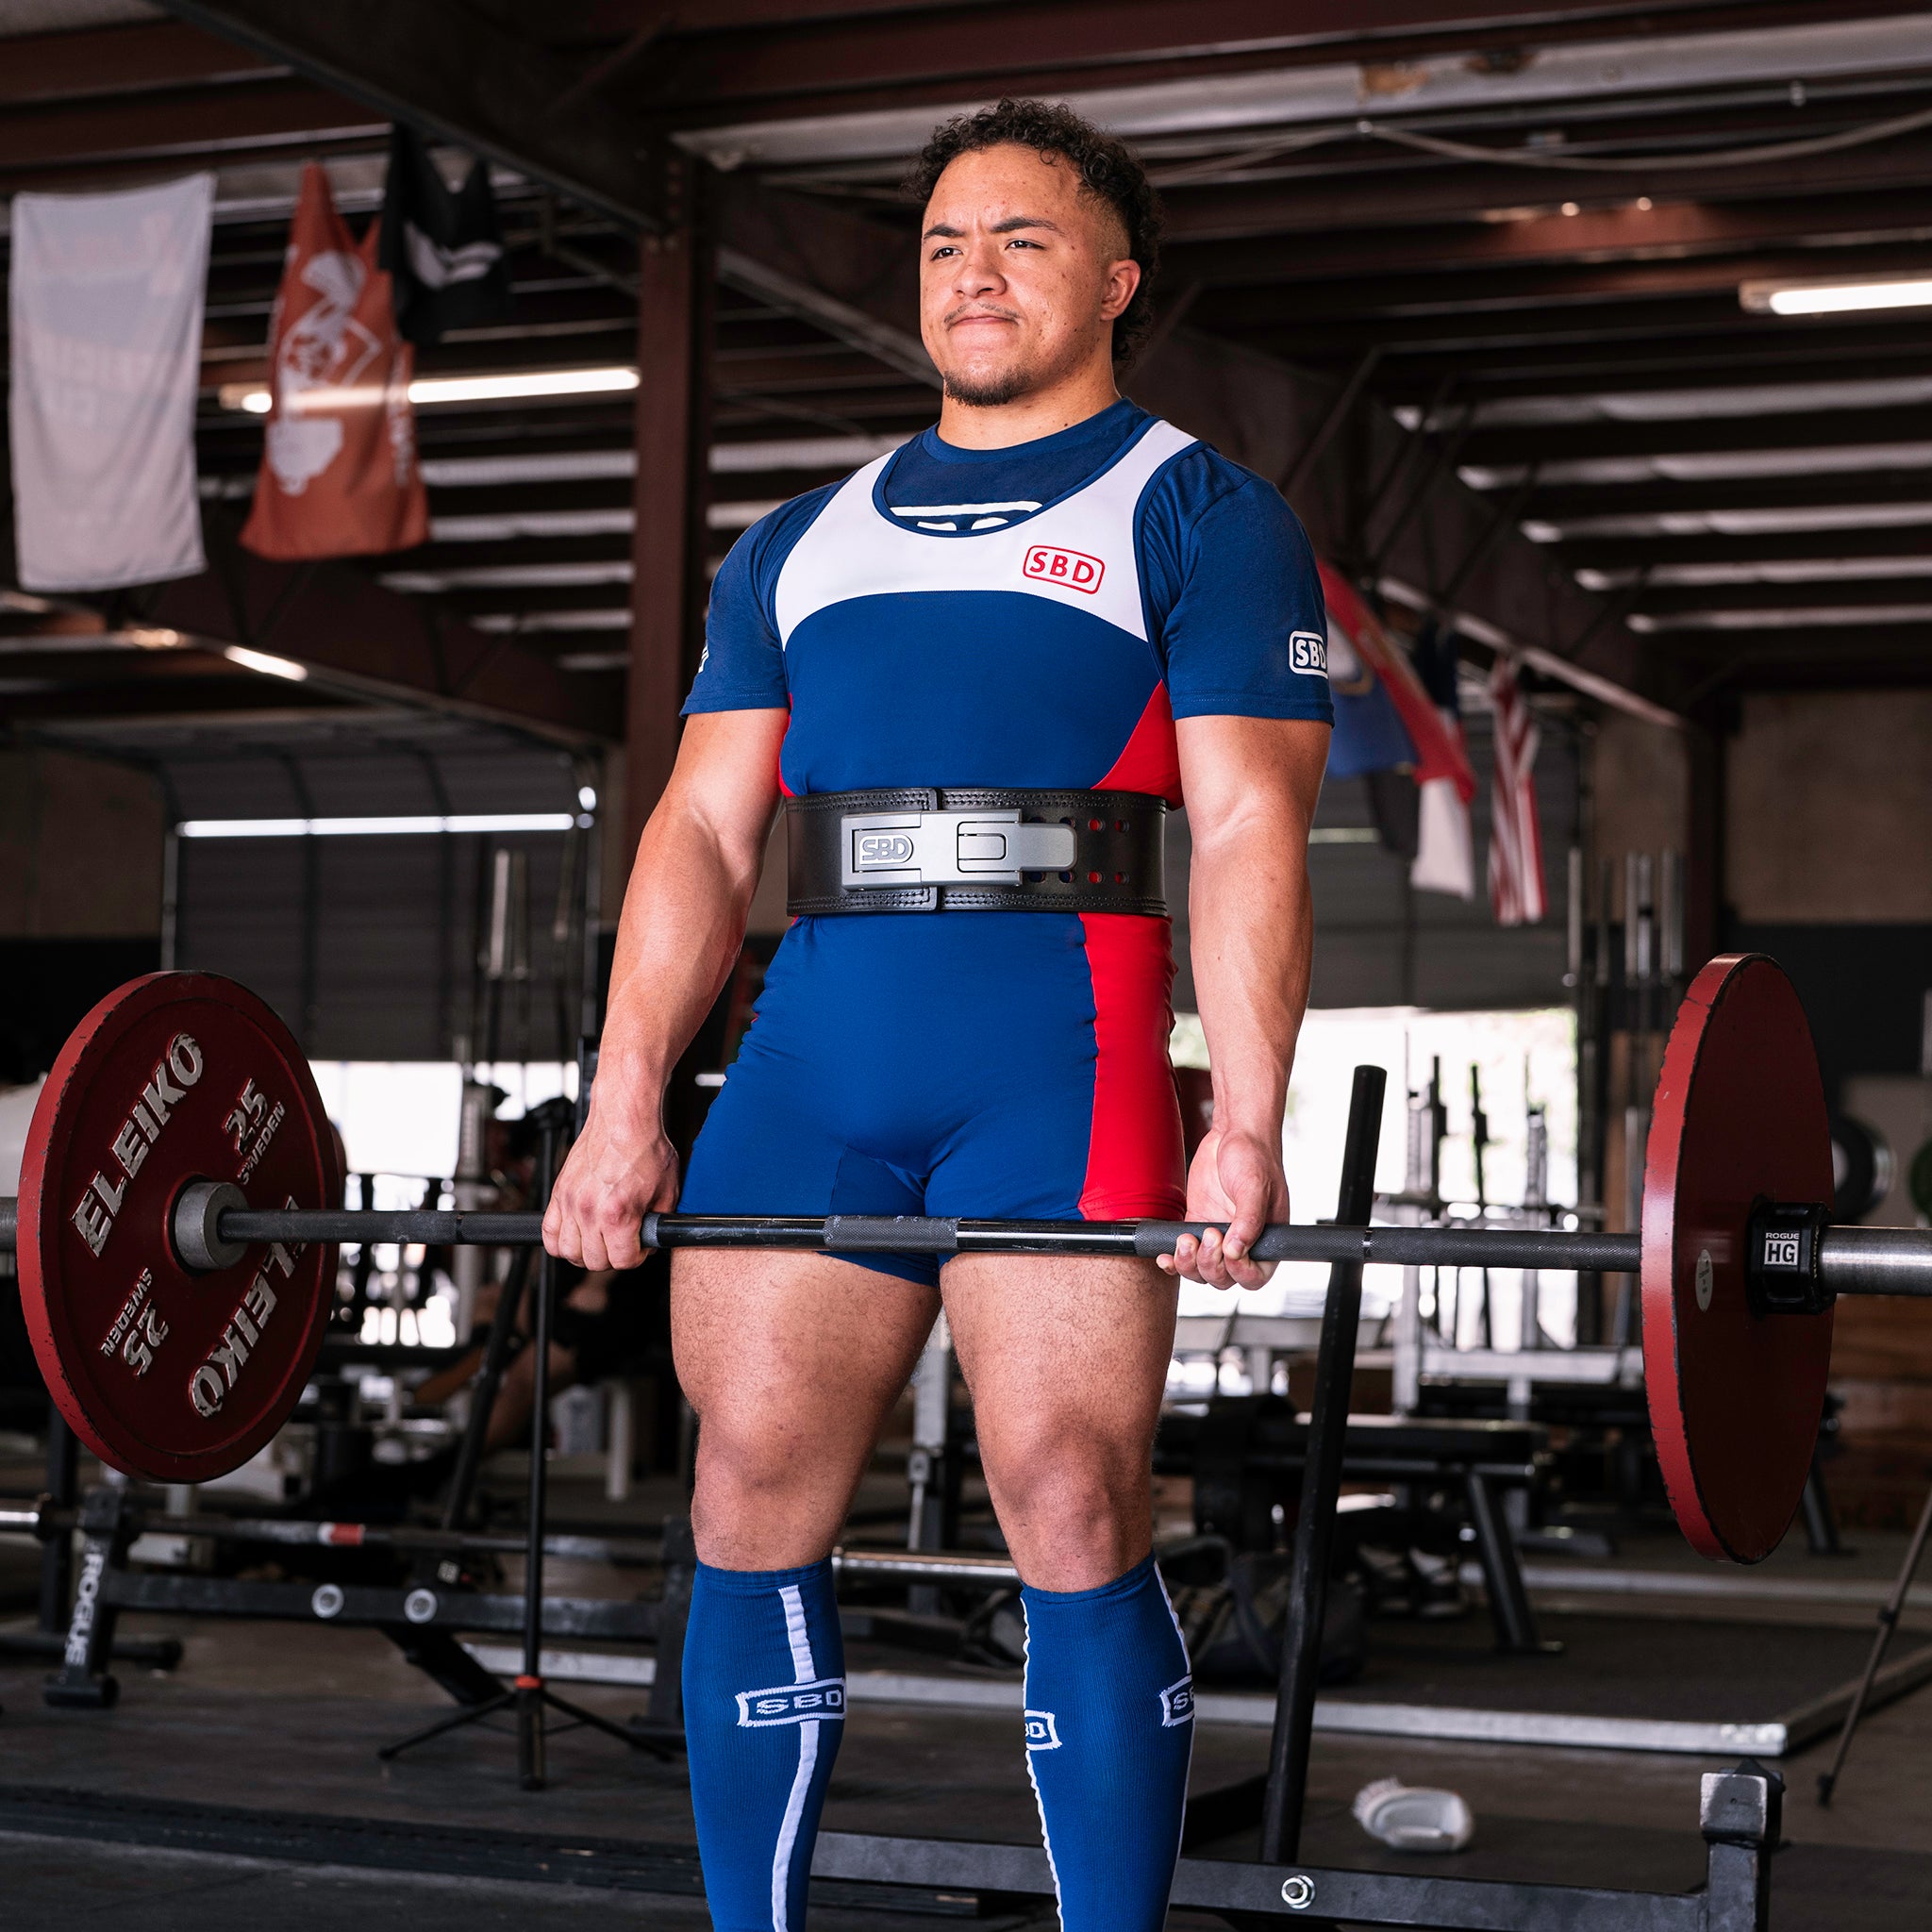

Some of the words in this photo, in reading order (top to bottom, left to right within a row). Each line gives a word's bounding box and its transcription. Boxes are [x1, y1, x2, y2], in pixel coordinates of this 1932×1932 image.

[1029, 551, 1094, 584] SBD
[1295, 639, 1326, 670] SBD
[862, 837, 910, 861] SBD
[225, 1077, 268, 1157] 25
[237, 1101, 286, 1185] SWEDEN
[71, 1032, 204, 1258] ELEIKO
[1765, 1232, 1800, 1241] ROGUE
[1766, 1241, 1797, 1263] HG
[100, 1267, 153, 1357] SWEDEN
[124, 1299, 170, 1376] 25
[65, 1553, 104, 1666] ROGUE
[756, 1690, 842, 1715] SBD
